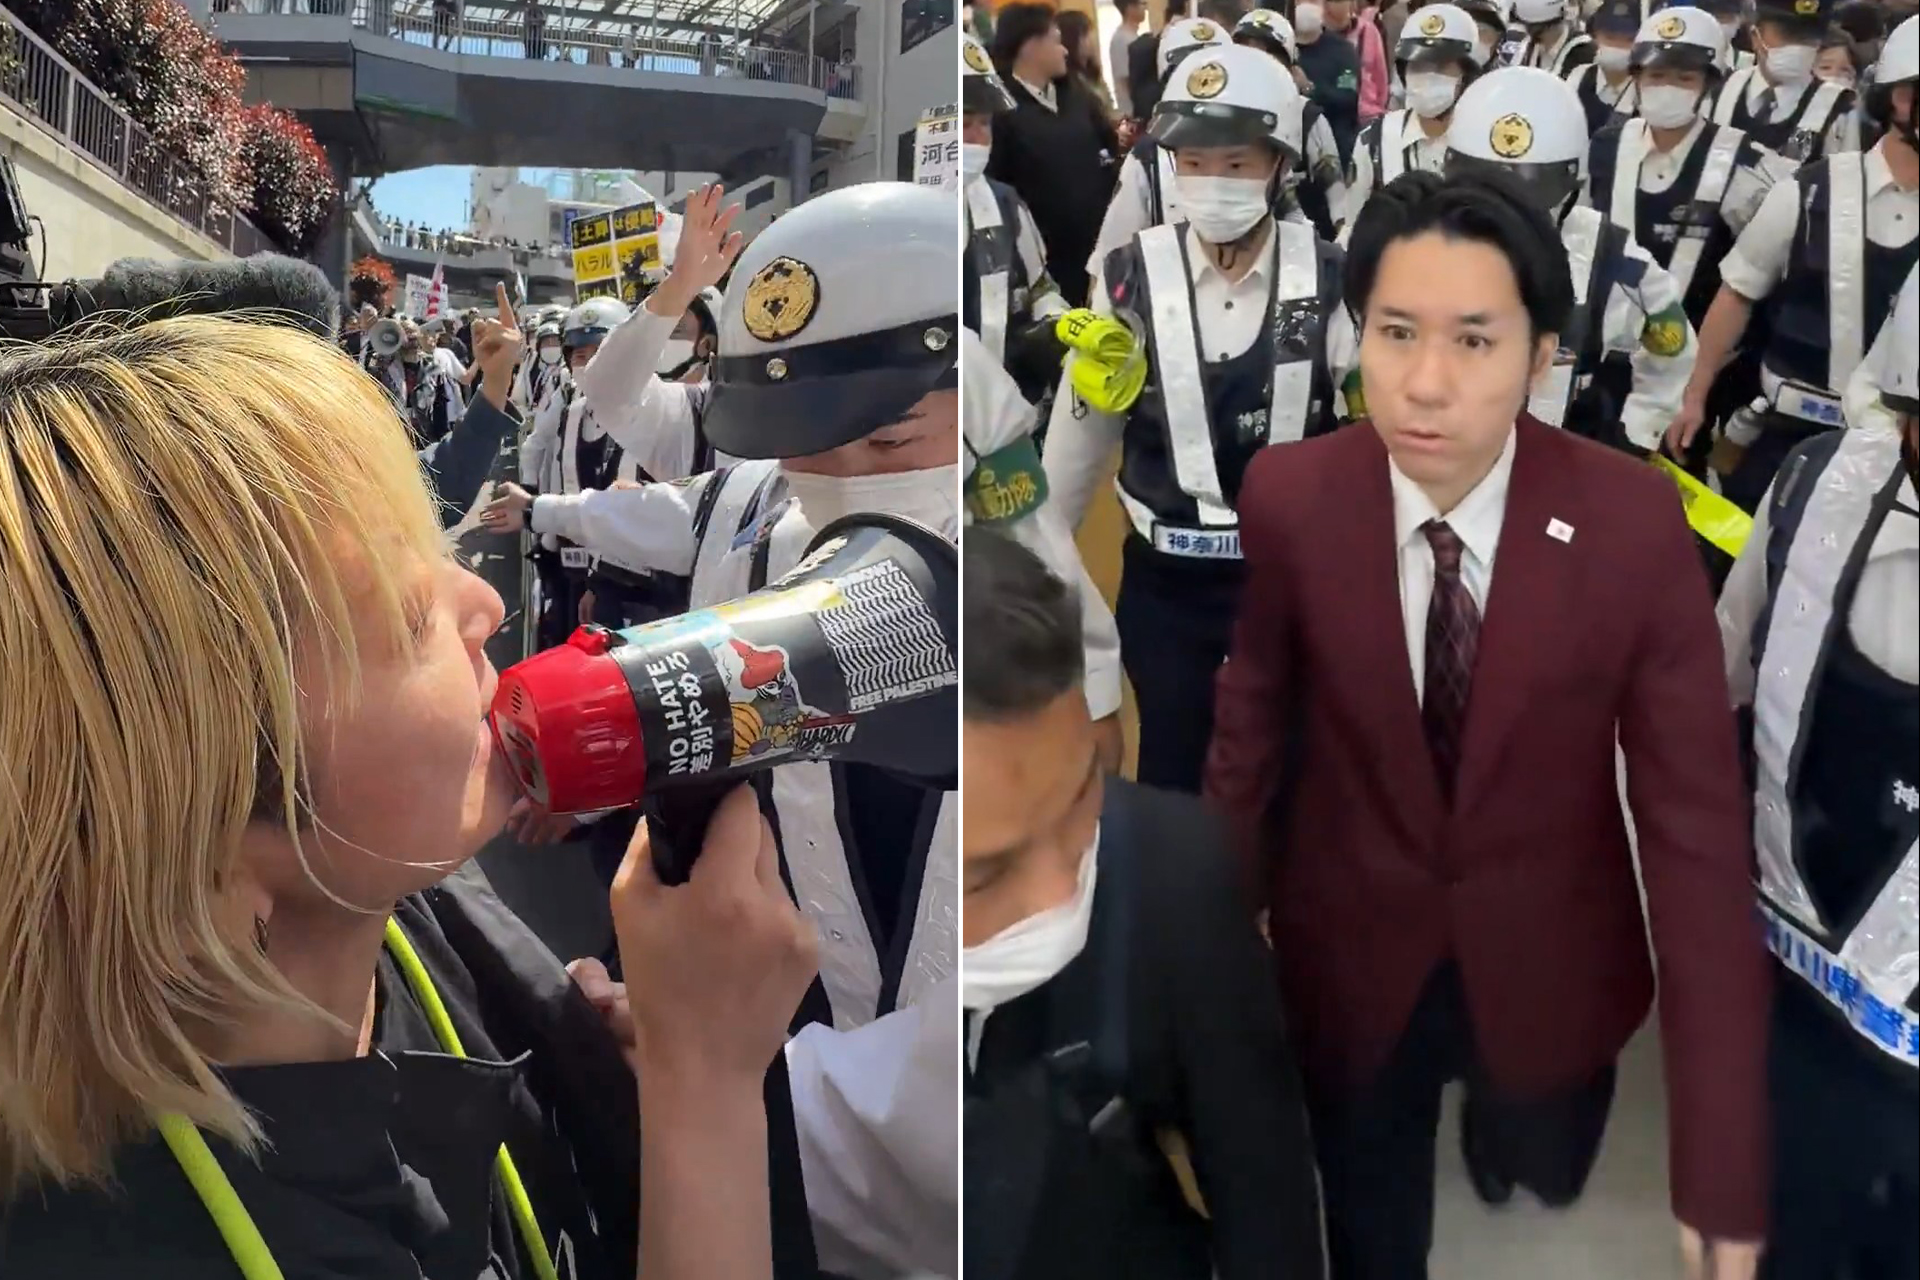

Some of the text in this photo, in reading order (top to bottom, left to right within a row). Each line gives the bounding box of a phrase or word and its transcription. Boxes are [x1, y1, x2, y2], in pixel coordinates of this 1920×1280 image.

[645, 660, 689, 775] NO HATE
[665, 650, 713, 774] 差別やめろ
[851, 691, 883, 711] FREE
